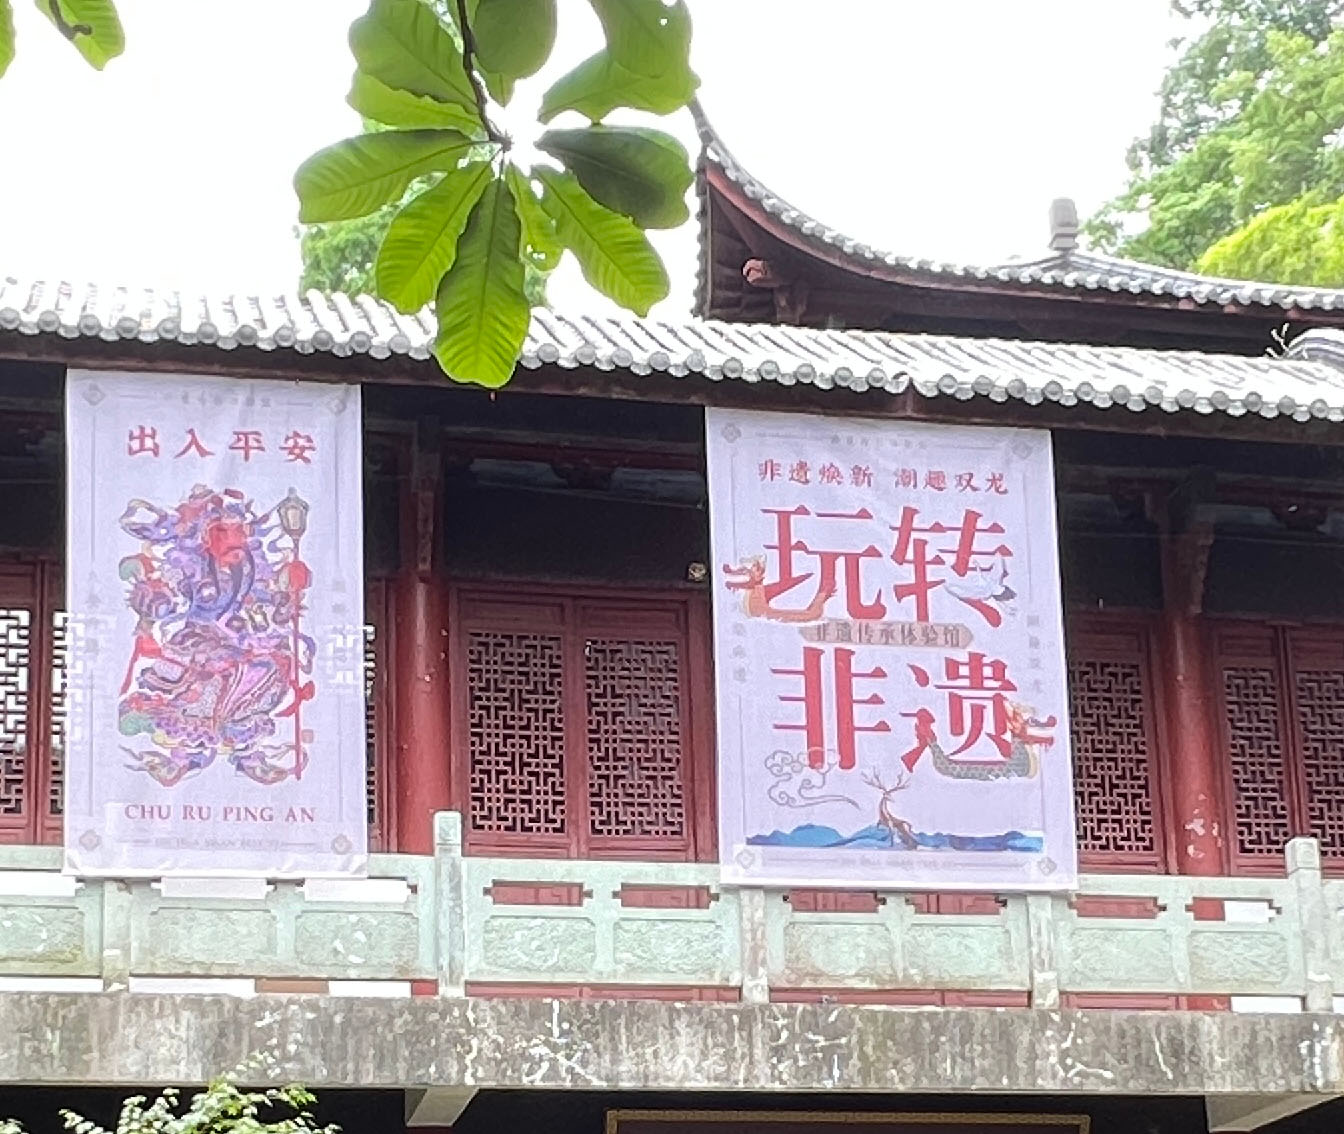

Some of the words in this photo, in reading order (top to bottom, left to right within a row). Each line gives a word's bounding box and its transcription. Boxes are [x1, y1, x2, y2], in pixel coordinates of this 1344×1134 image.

[128, 425, 316, 464] 出入平安
[758, 458, 874, 488] 非遗焕新
[759, 504, 1014, 628] 玩转
[769, 646, 1018, 774] 非遗
[124, 804, 172, 820] CHU
[182, 805, 212, 821] RU
[222, 806, 274, 822] PING
[285, 806, 316, 823] AN
